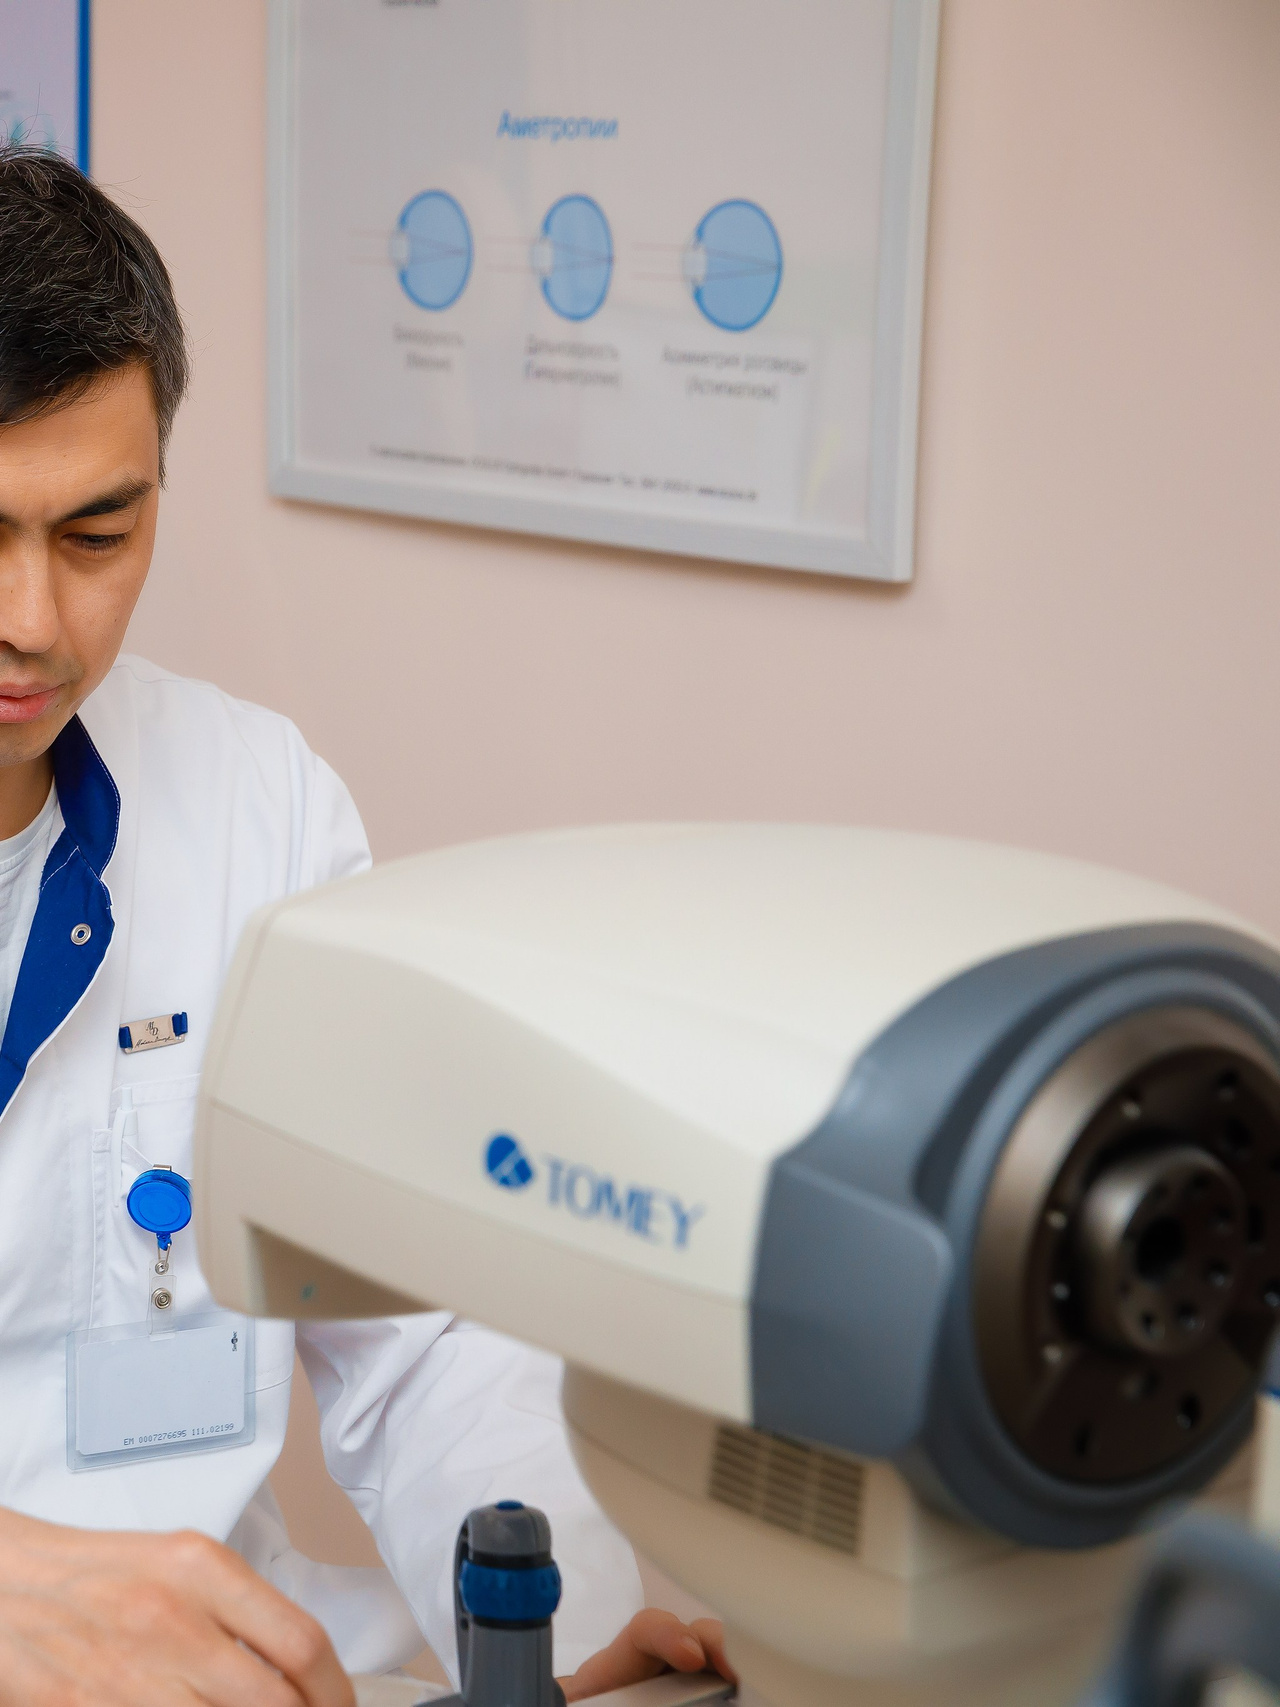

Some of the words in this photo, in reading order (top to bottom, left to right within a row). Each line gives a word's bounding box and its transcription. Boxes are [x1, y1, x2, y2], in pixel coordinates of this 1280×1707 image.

[496, 109, 618, 143] Аметропии
[541, 1153, 707, 1249] TOMEY
[123, 1438, 135, 1446] EM
[138, 1429, 187, 1444] 0007276695
